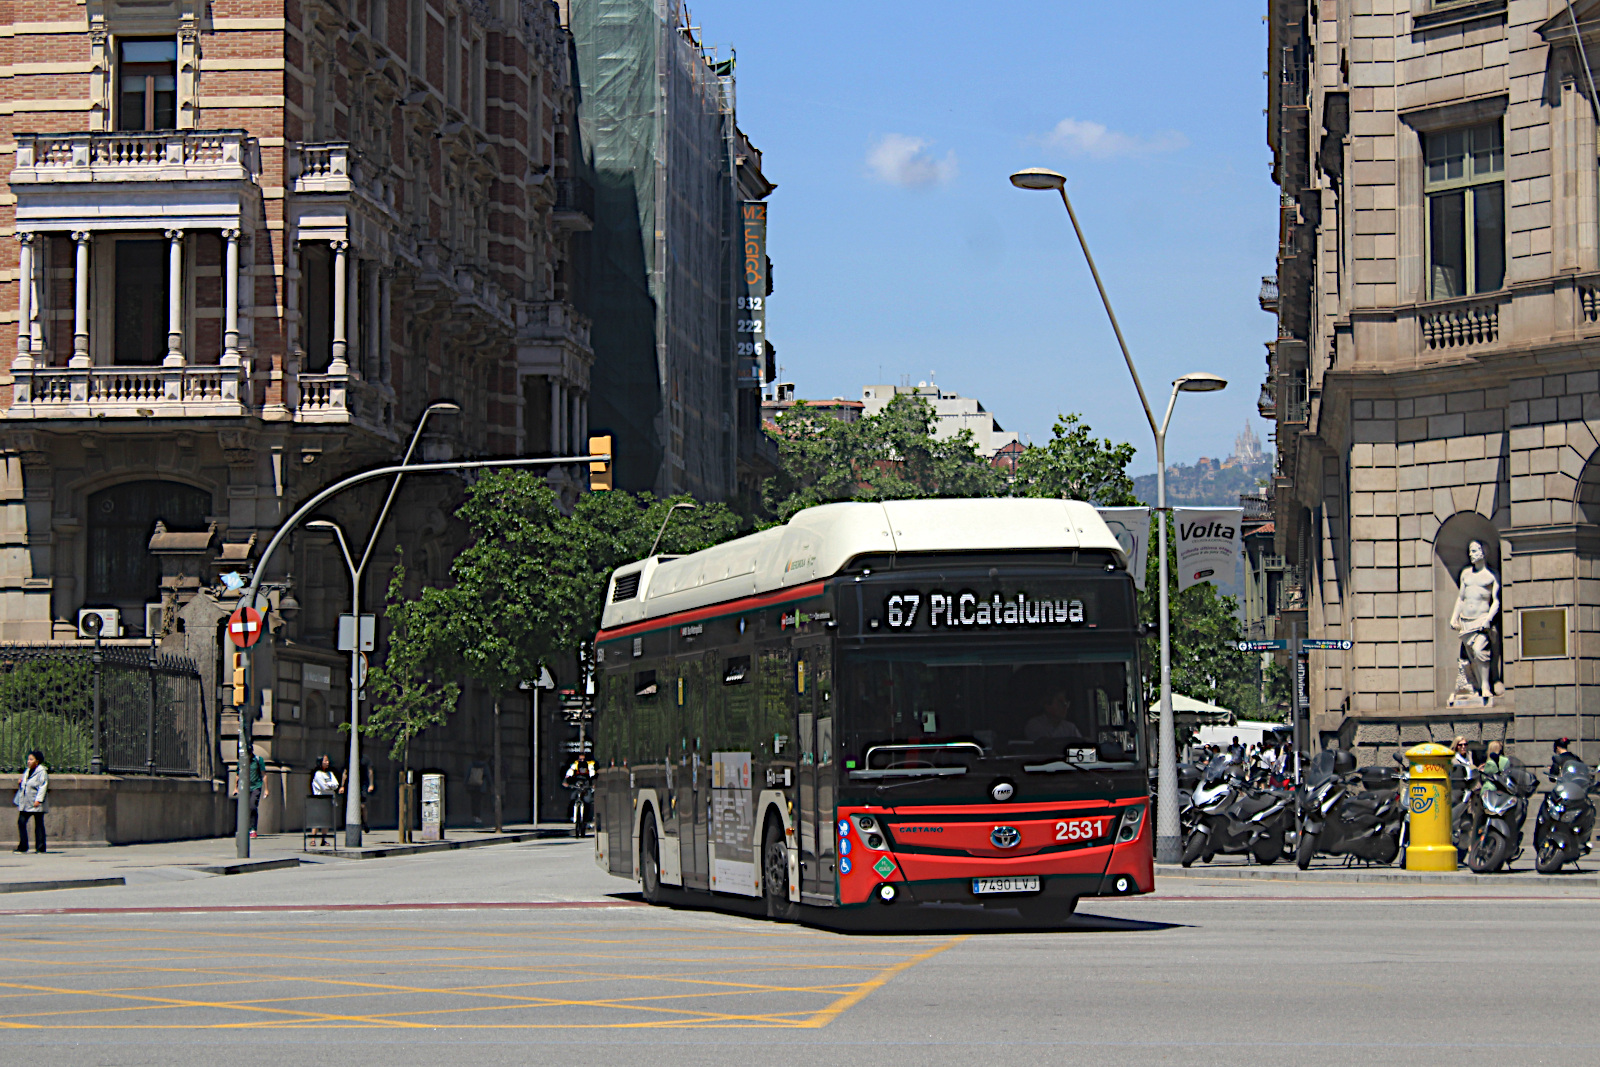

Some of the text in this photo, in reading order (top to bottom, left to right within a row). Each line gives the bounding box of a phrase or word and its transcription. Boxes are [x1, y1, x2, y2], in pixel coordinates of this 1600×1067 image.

[741, 206, 766, 220] M2
[744, 228, 763, 285] J.GIGÓ
[737, 296, 762, 310] 932
[737, 319, 762, 333] 222
[737, 342, 762, 356] 296
[1180, 522, 1235, 541] Volta
[888, 593, 1084, 627] 67 Pl.Catalunya
[1055, 821, 1102, 841] 2531
[981, 878, 1037, 891] 7490 LVJ
